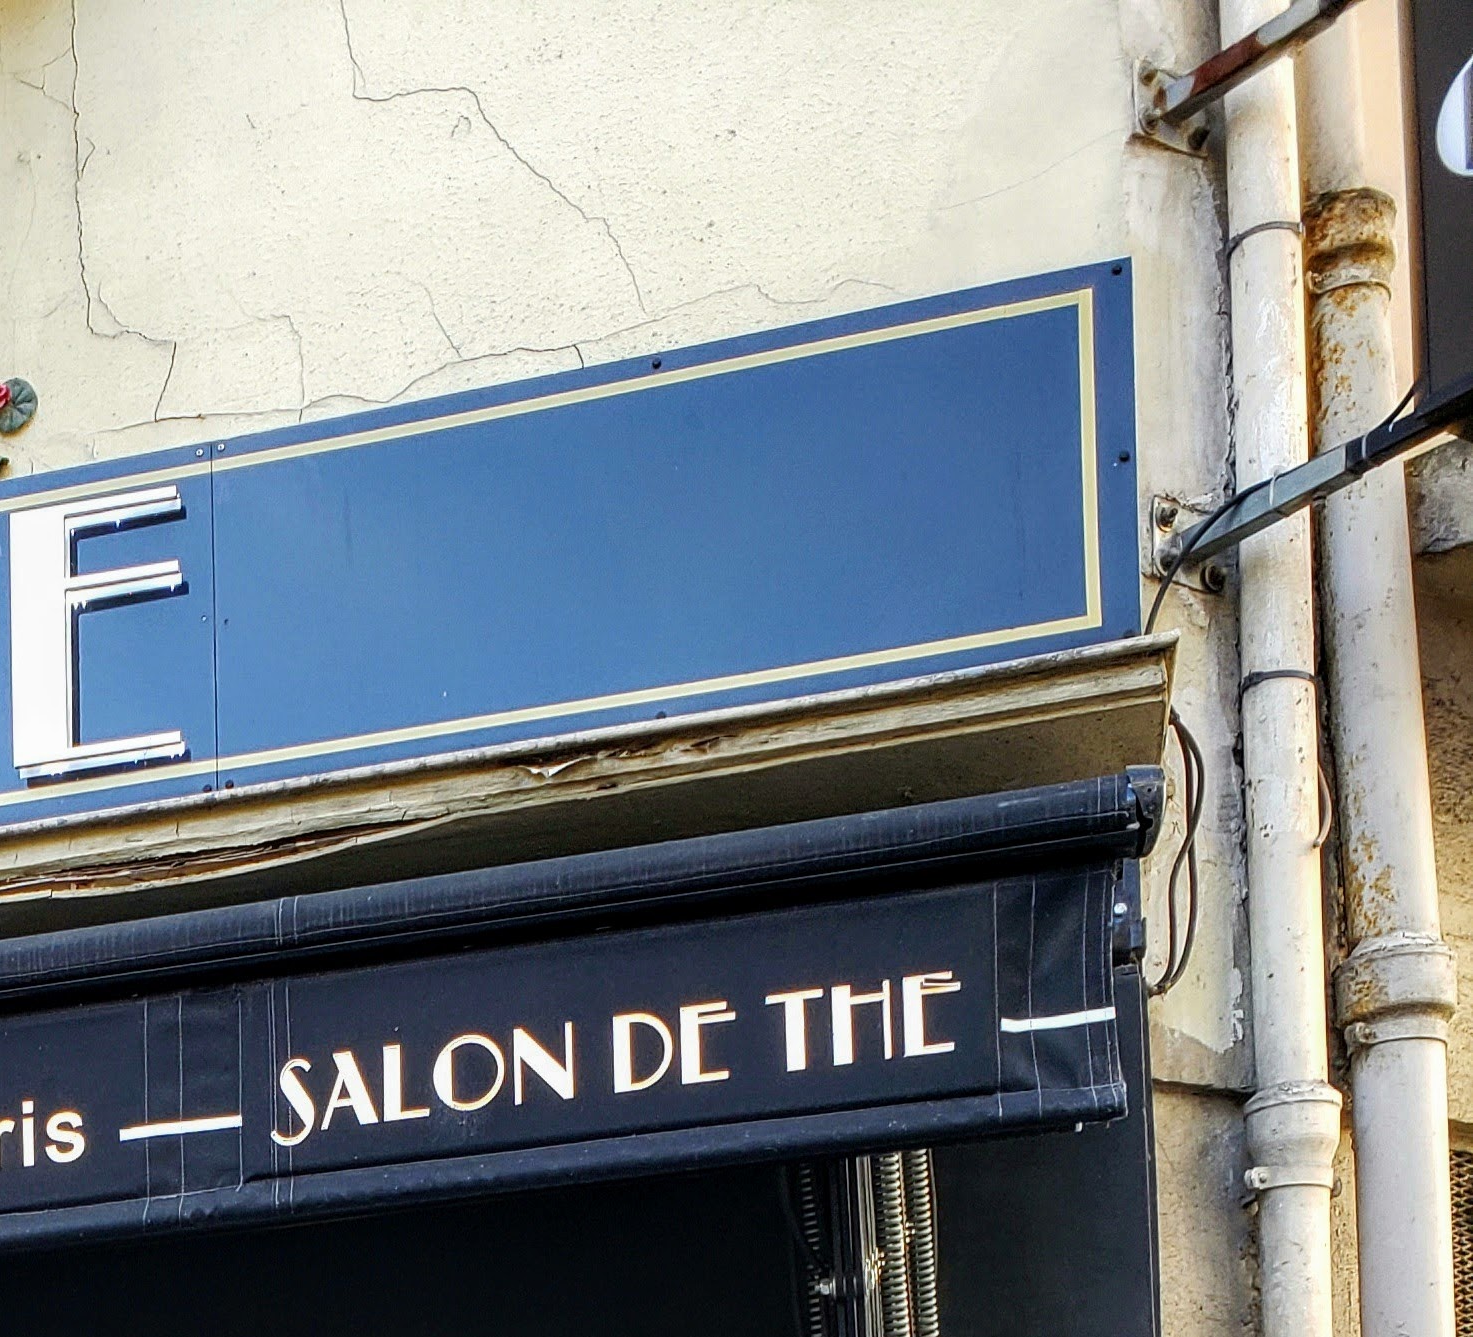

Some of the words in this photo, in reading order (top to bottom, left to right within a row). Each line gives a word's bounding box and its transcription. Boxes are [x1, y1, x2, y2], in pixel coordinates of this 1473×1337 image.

[271, 1022, 574, 1146] SALON
[613, 1001, 735, 1093] DE
[765, 971, 960, 1071] THE
